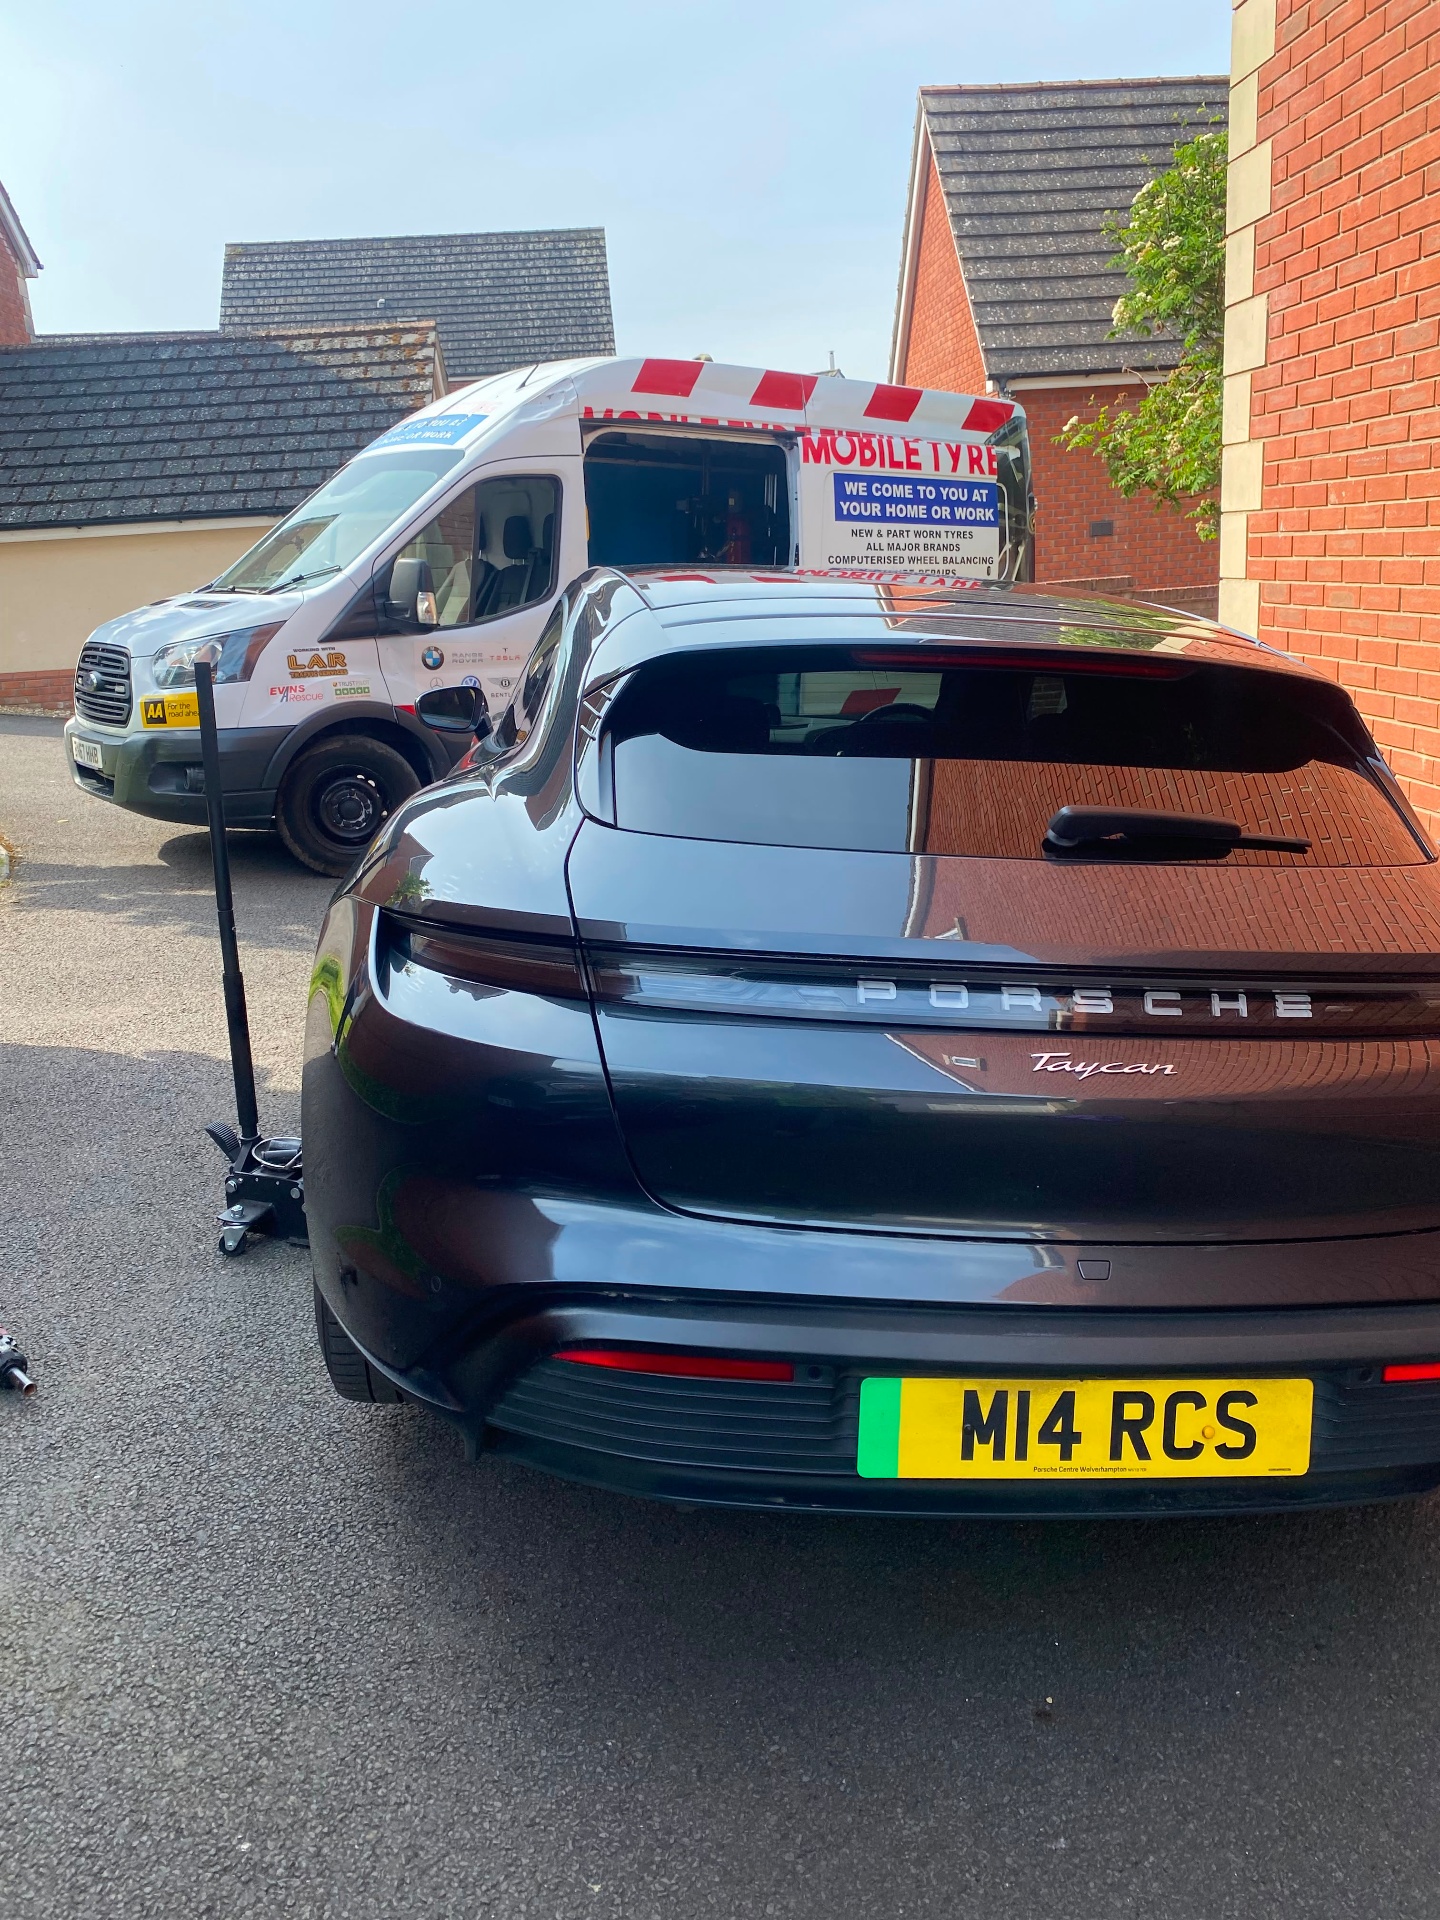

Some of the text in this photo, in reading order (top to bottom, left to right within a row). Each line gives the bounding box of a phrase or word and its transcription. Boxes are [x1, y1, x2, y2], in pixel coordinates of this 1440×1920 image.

[802, 436, 922, 471] MOBILE
[844, 481, 989, 502] WE COME TO YOU AT
[840, 501, 995, 521] YOUR HOME OR WORK
[851, 528, 973, 539] NEW & PART WORN TYRES
[866, 542, 960, 552] ALL MAJOR BRANDS
[828, 555, 994, 565] COMPUTERISED WHEEL BALANCING
[287, 652, 347, 670] LAR
[289, 670, 318, 678] TRAFFIC
[269, 684, 305, 701] EVANS
[289, 693, 324, 701] Rescue
[147, 703, 163, 718] AA
[857, 980, 1313, 1018] PORSCHE
[1029, 1051, 1179, 1081] Taycan
[1109, 1390, 1259, 1461] RCS
